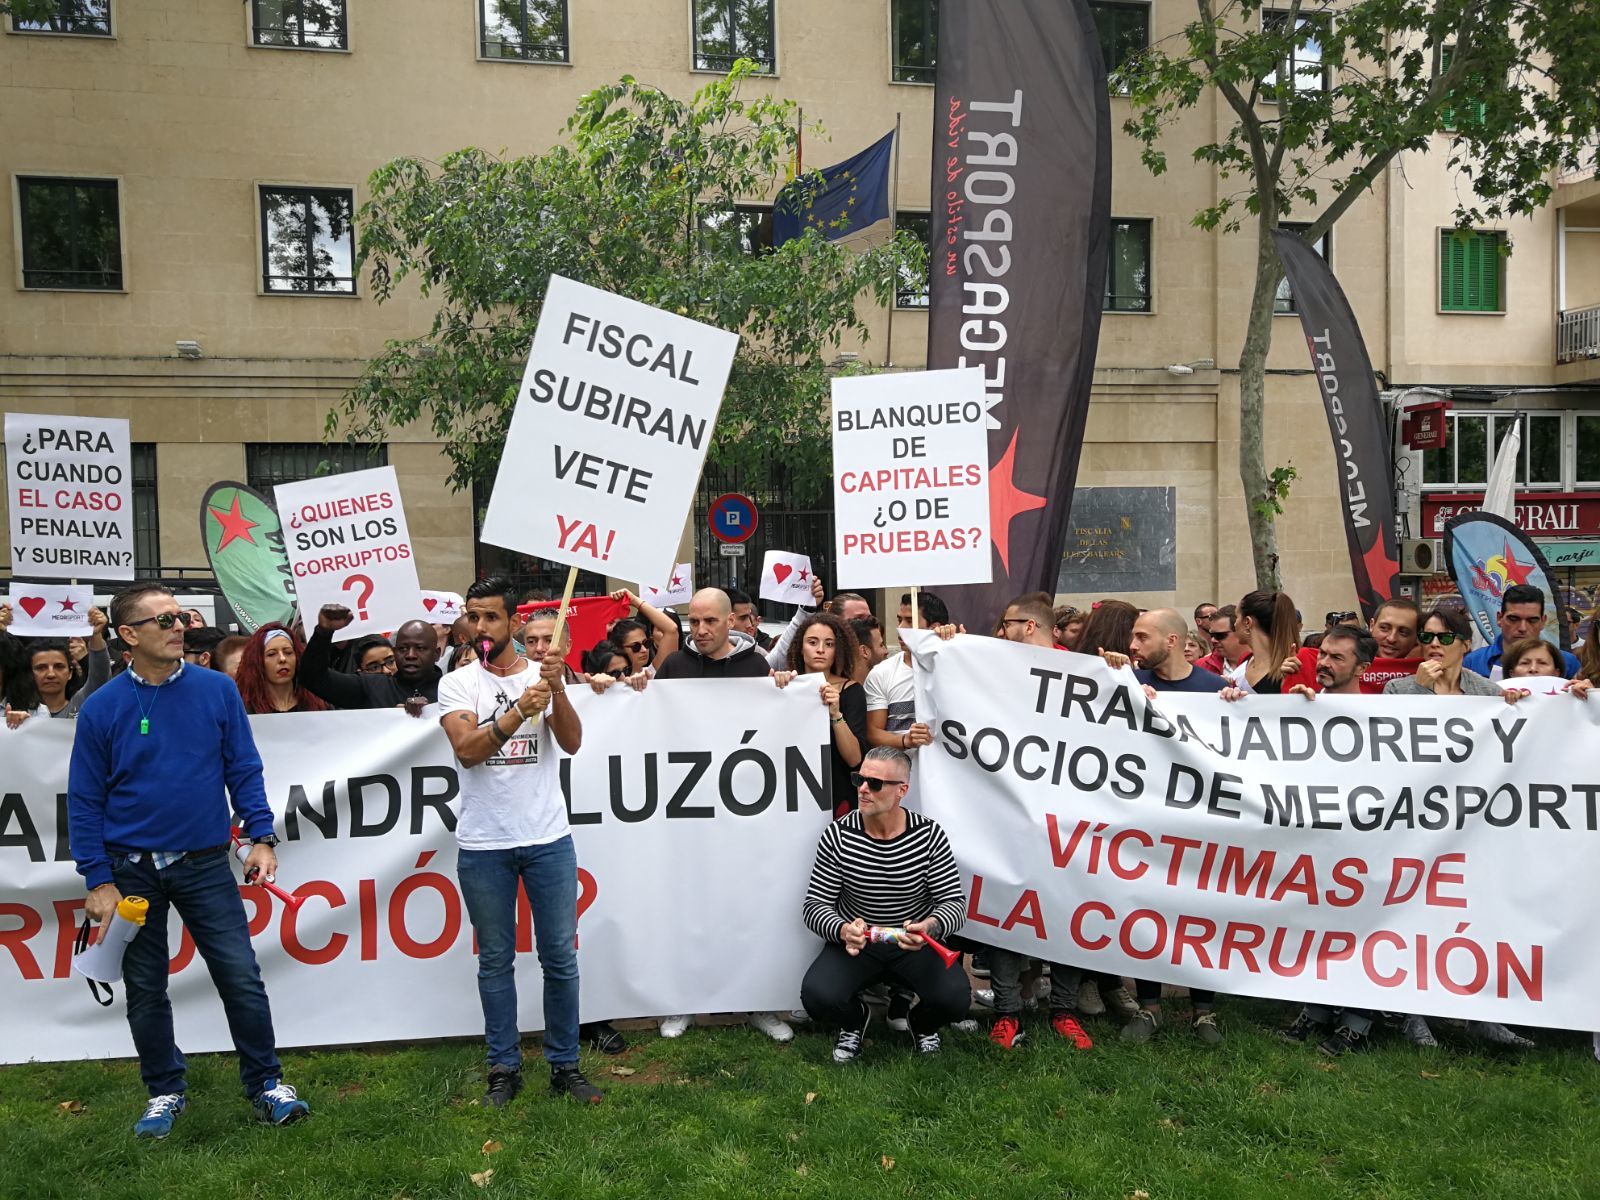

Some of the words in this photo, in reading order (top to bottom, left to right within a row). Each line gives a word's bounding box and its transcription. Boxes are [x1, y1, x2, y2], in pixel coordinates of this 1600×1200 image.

[562, 311, 700, 386] FISCAL
[529, 369, 707, 450] SUBIRAN
[837, 401, 982, 431] BLANQUEO
[21, 428, 115, 454] ¿PARA
[892, 437, 926, 459] DE
[16, 460, 122, 485] CUANDO
[554, 444, 653, 503] VETE
[840, 464, 982, 494] CAPITALES
[19, 489, 47, 507] EL
[54, 490, 122, 512] CASO
[290, 492, 393, 529] ¿QUIENES
[873, 501, 906, 527] ¿O
[916, 498, 949, 520] DE
[20, 518, 122, 539] PENALVA
[1456, 503, 1581, 533] ERALI
[296, 525, 345, 551] SON
[353, 518, 398, 542] LOS
[555, 514, 616, 561] YA!
[843, 527, 982, 555] PRUEBAS?
[14, 547, 26, 562] Y
[32, 548, 132, 568] SUBIRAN?
[294, 543, 411, 577] CORRUPTOS
[1030, 667, 1474, 764] TRABAJADORES
[1491, 717, 1527, 763] Y
[510, 739, 538, 757] 27N
[559, 729, 832, 826] LUZÓN
[941, 719, 1146, 800] SOCIOS
[1165, 762, 1244, 819] DE
[1260, 782, 1600, 831] MEGASPORT
[1383, 852, 1468, 909] DE
[966, 874, 1048, 941] LA
[1070, 900, 1543, 1003] CORRUPCIÓN
